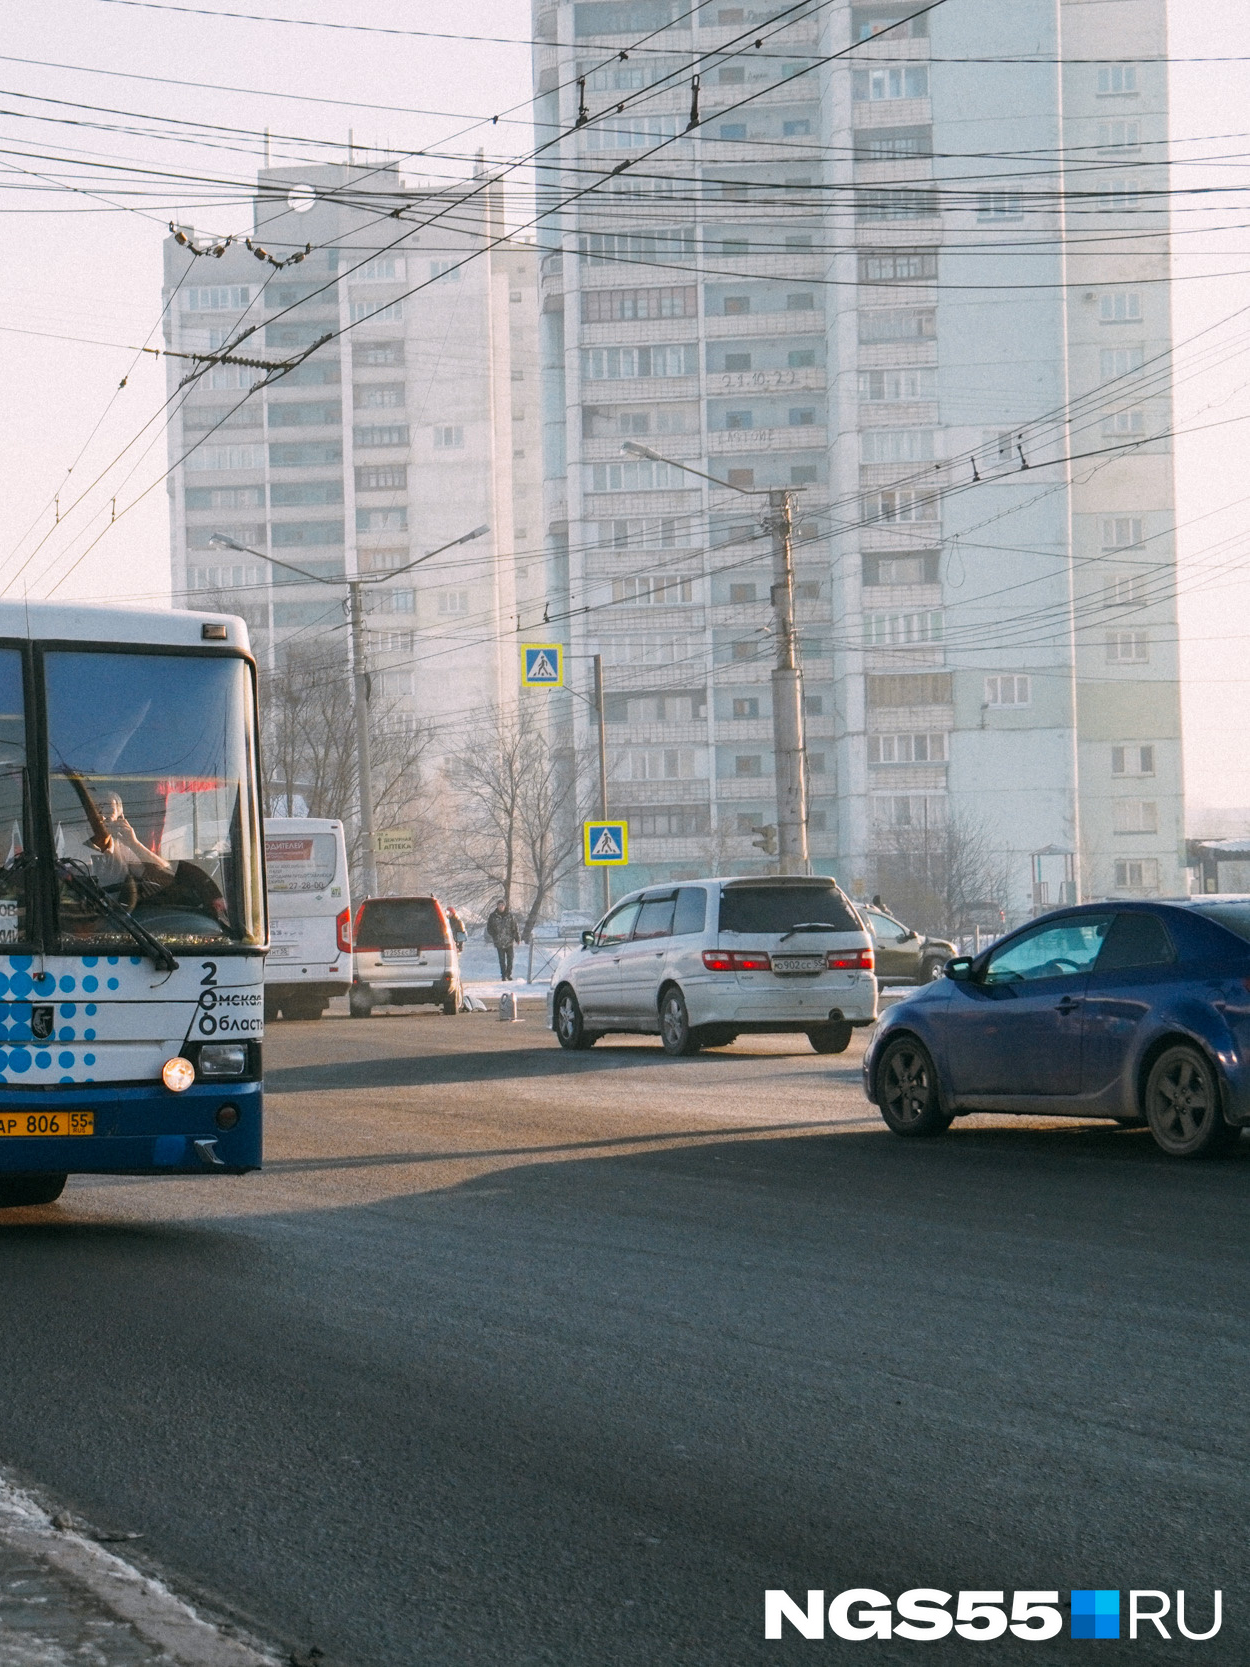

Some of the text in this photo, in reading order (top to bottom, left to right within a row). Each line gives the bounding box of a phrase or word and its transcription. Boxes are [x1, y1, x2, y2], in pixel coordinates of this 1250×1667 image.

[200, 961, 218, 985] 2
[199, 989, 262, 1011] Омская
[26, 1115, 60, 1133] 806
[71, 1114, 88, 1128] 55
